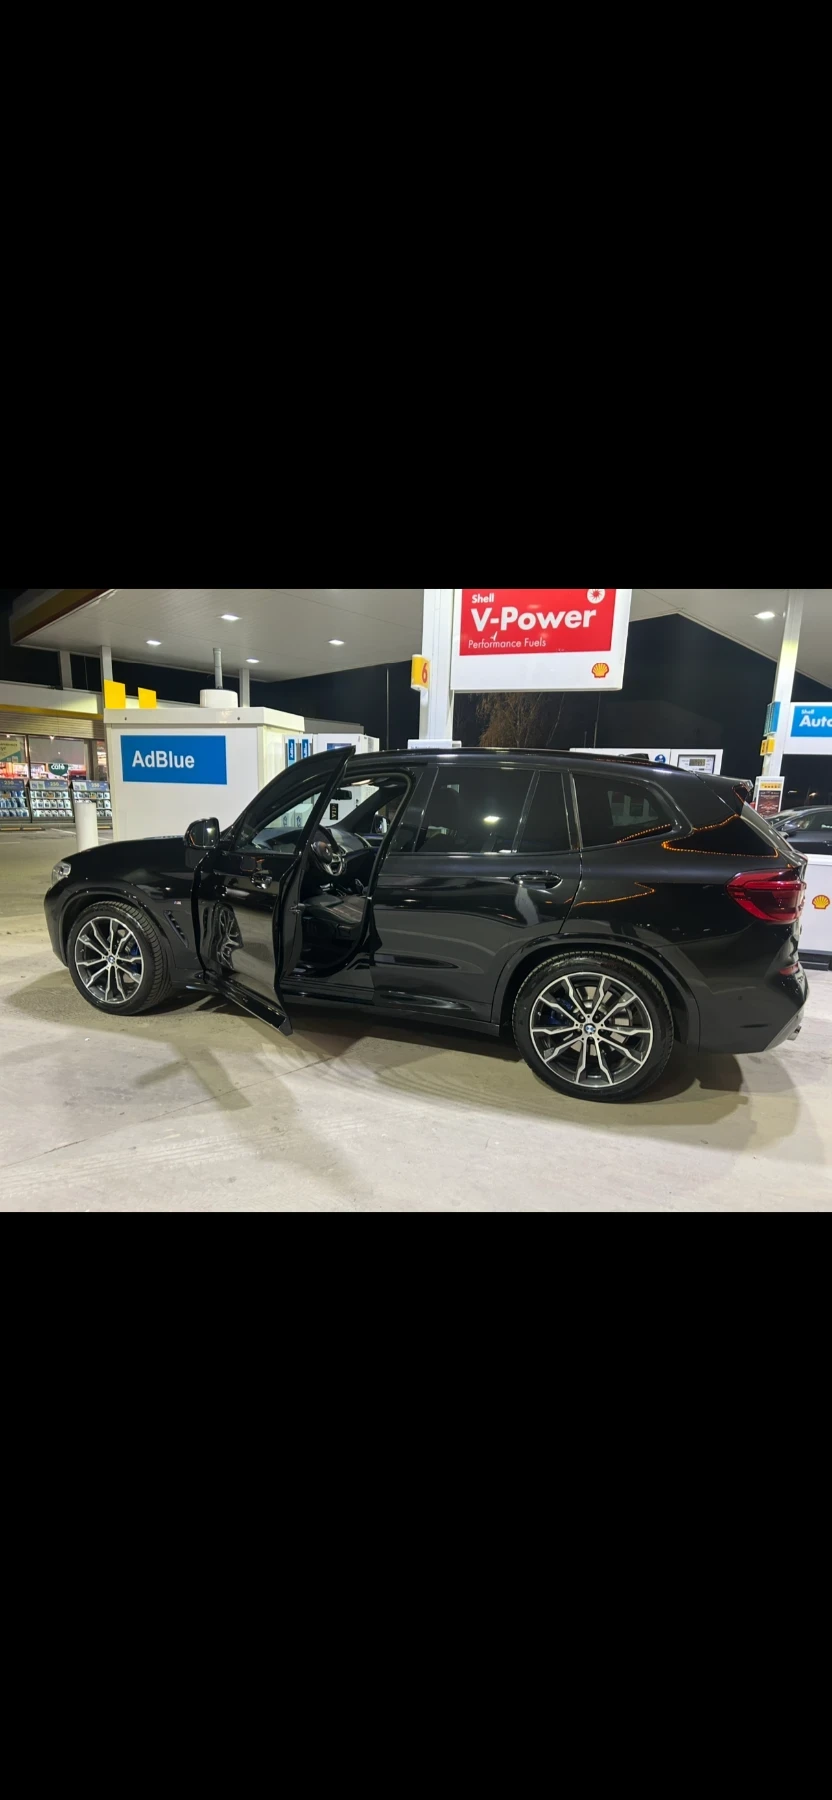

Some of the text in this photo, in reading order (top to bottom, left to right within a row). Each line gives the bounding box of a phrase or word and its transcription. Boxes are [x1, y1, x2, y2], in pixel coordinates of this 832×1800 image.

[471, 593, 495, 604] Shell
[470, 606, 597, 632] V-Power
[468, 637, 546, 649] Performance Fuels
[421, 662, 428, 684] 6
[132, 750, 195, 769] AdBlue
